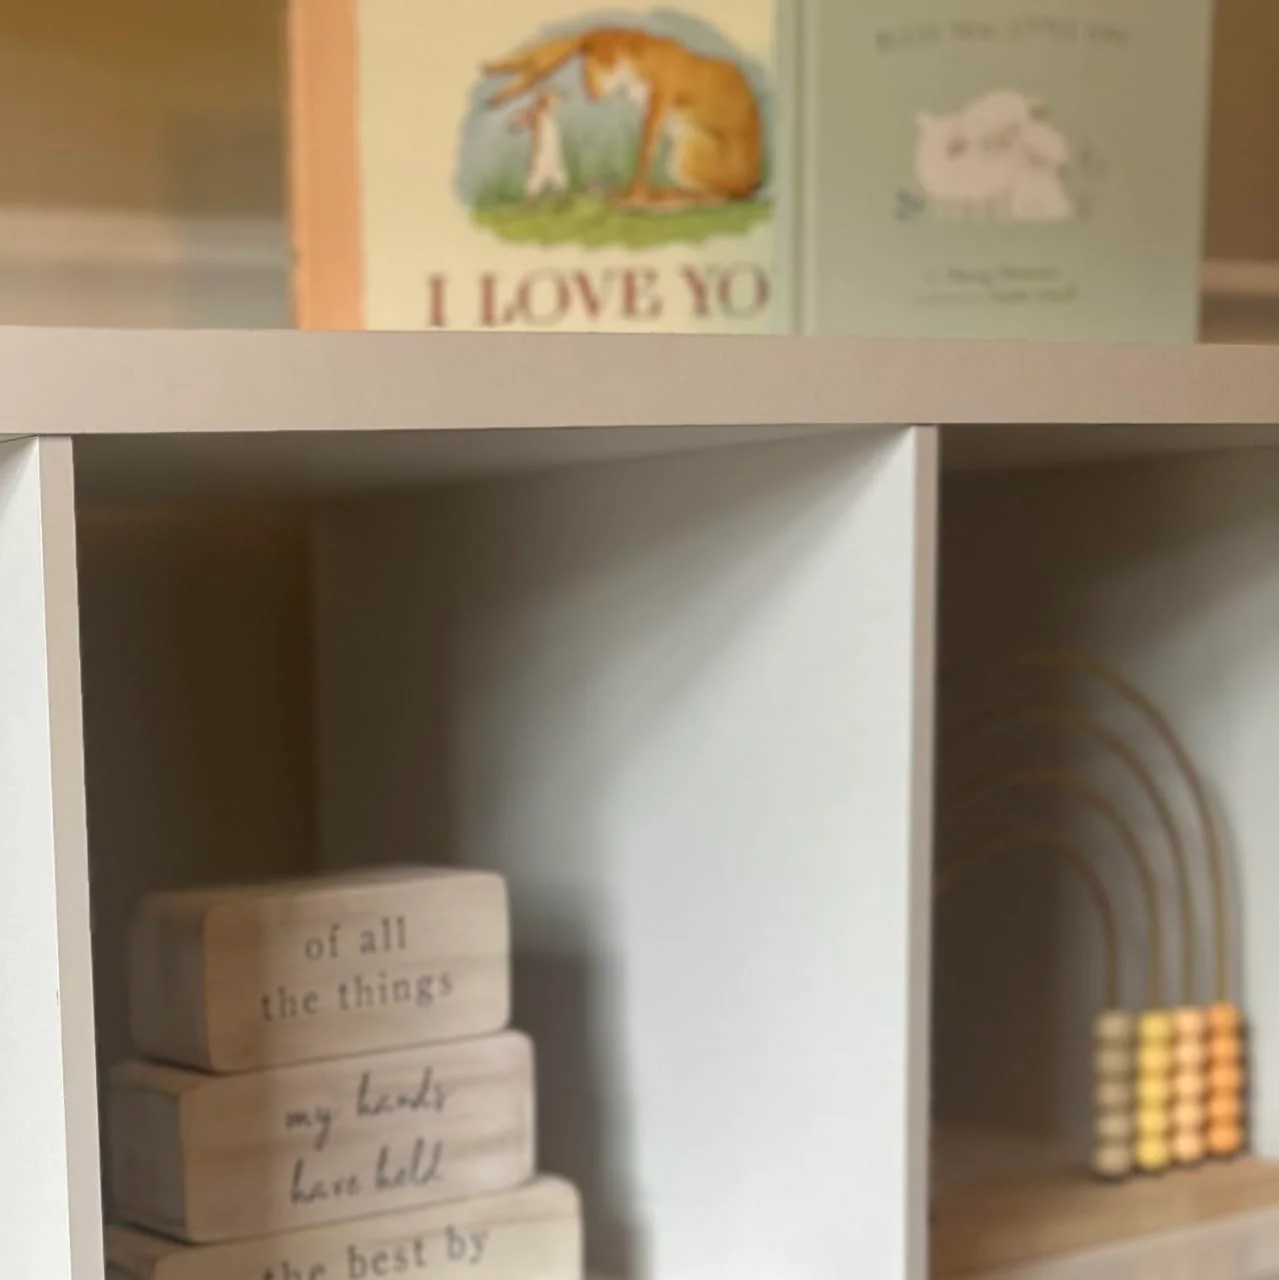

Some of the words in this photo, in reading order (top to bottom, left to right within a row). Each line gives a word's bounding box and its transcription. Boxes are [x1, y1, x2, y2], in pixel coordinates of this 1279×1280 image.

[427, 271, 449, 328] I
[477, 265, 665, 328] LOVE
[305, 922, 341, 961] of
[358, 915, 407, 954] all
[261, 984, 320, 1022] the
[337, 970, 454, 1011] things
[285, 1106, 333, 1152] my
[357, 1066, 447, 1117] hands
[289, 1157, 360, 1205] have
[375, 1136, 445, 1191] held
[347, 1236, 427, 1280] best
[445, 1224, 489, 1266] by
